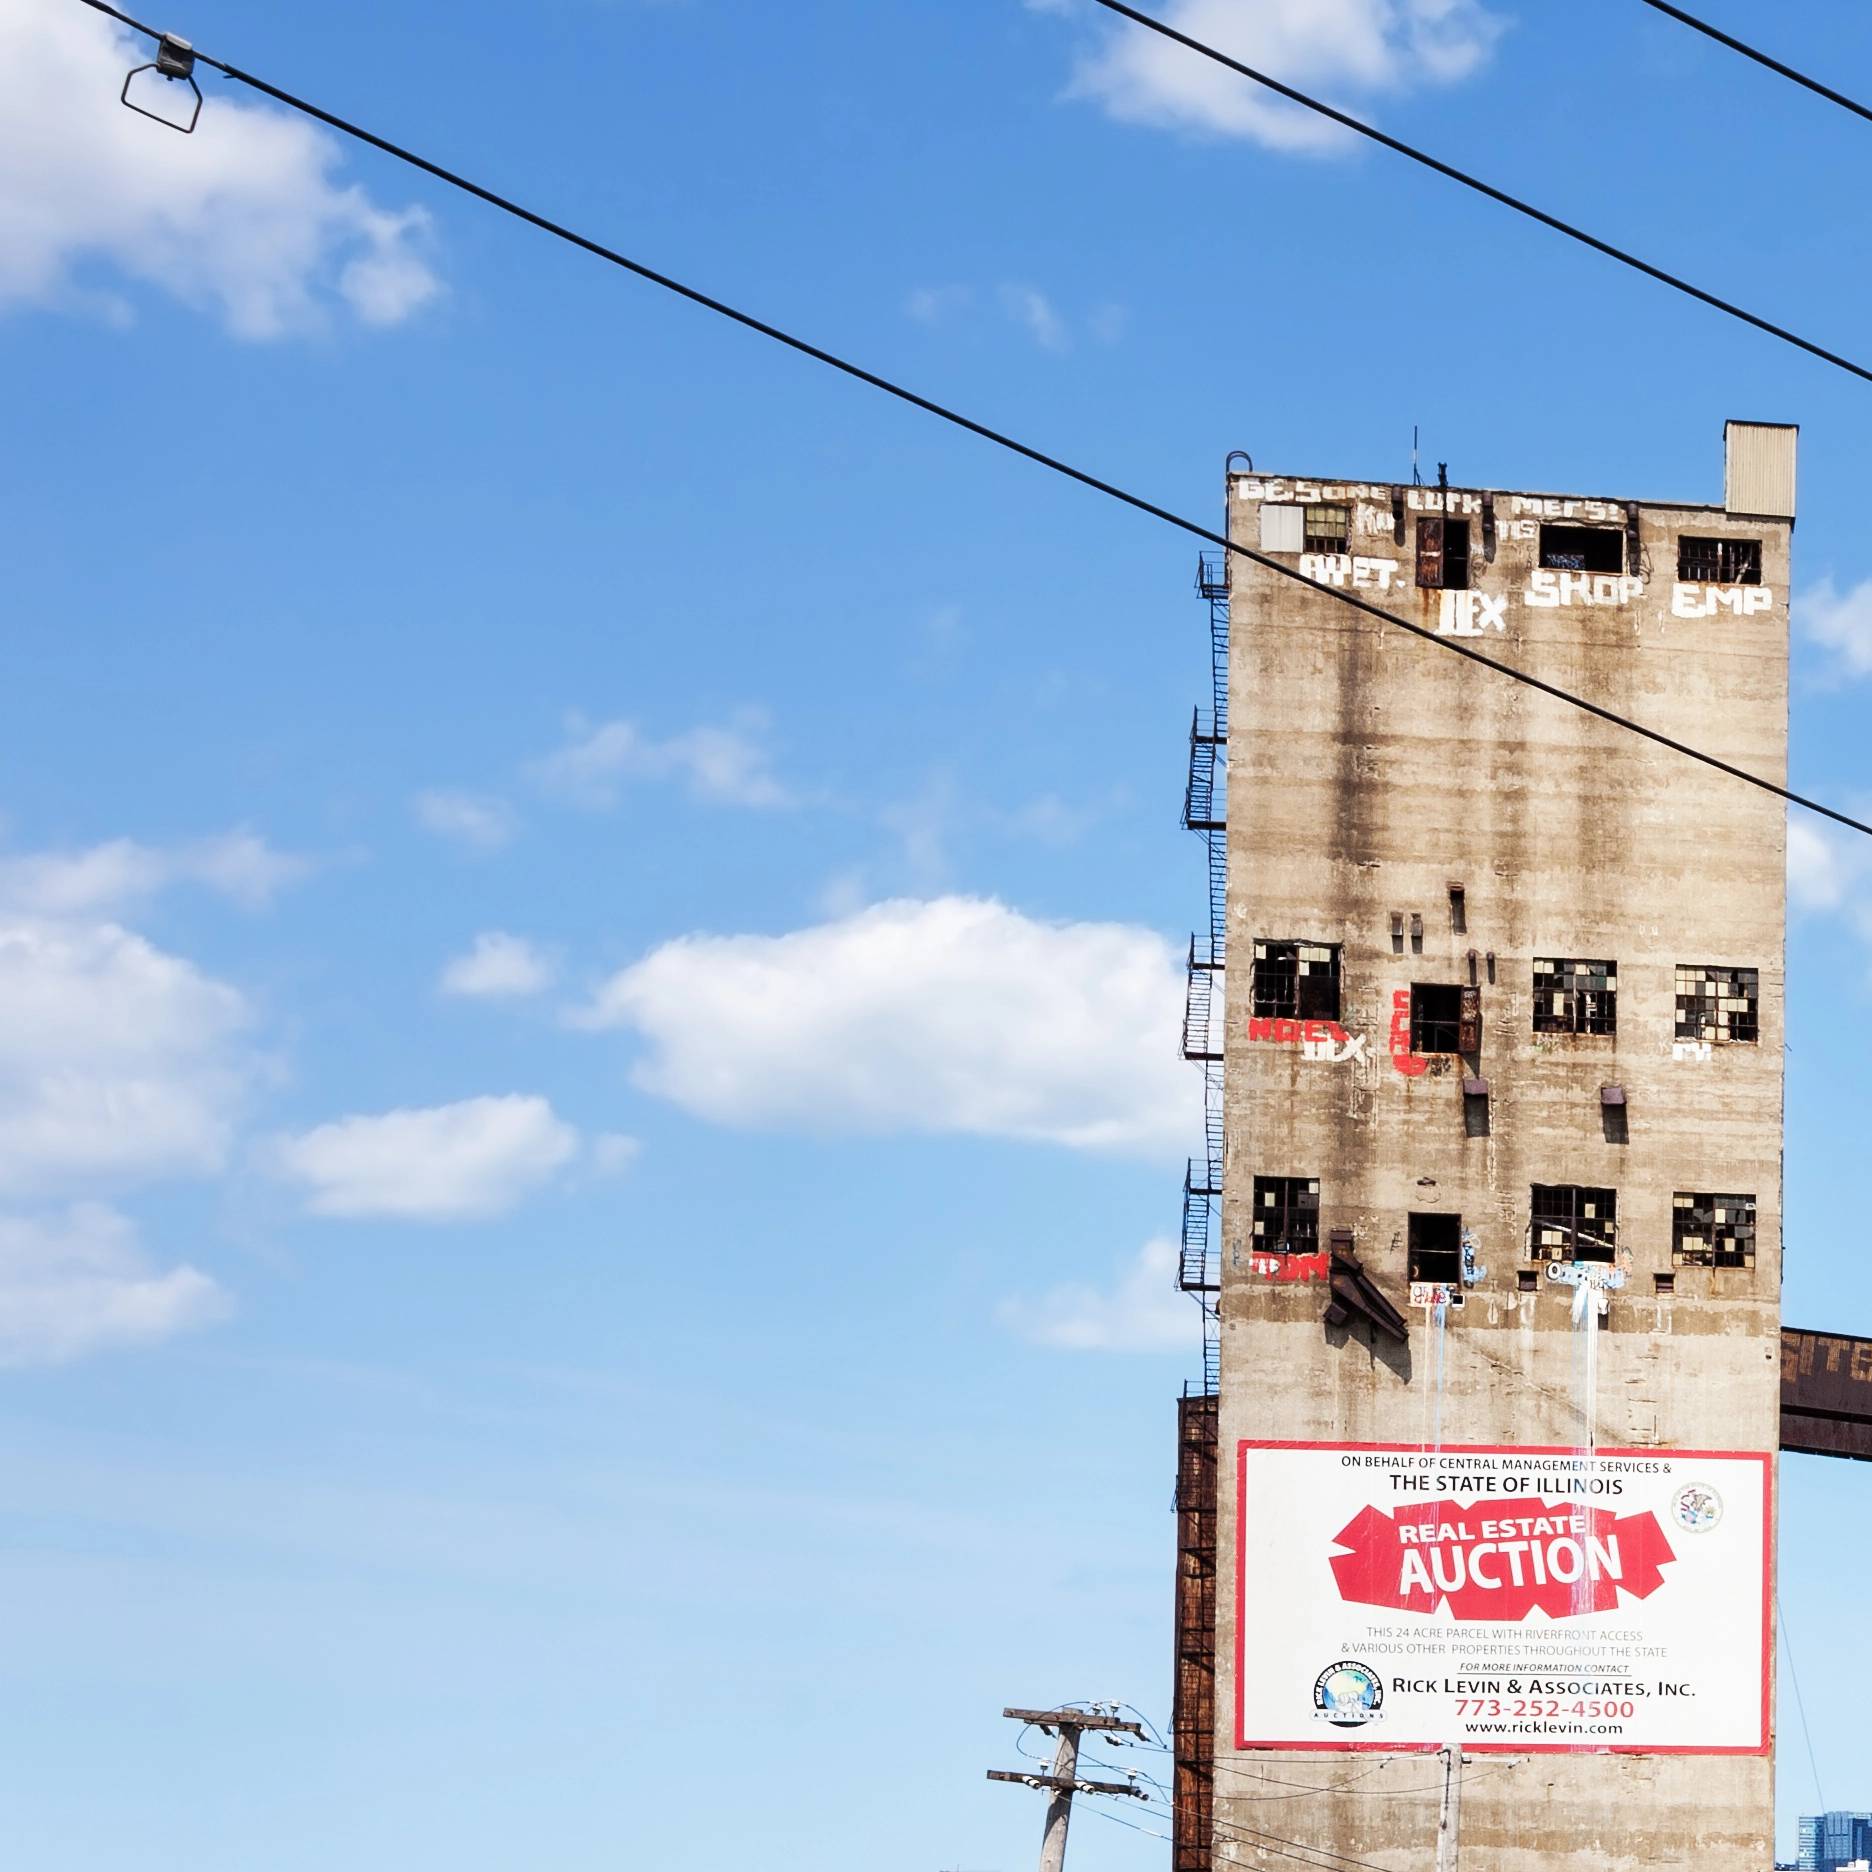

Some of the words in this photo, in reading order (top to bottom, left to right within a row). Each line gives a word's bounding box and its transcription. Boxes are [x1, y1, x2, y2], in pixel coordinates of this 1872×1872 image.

[1342, 1456, 1360, 1467] ON
[1365, 1457, 1414, 1468] BEHALF
[1419, 1458, 1435, 1469] OF
[1440, 1458, 1498, 1470] CENTRAL
[1502, 1460, 1596, 1473] MANAGEMENT
[1600, 1462, 1659, 1474] SERVICES
[1663, 1464, 1672, 1474] &
[1389, 1475, 1429, 1491] THE
[1436, 1476, 1496, 1493] STATE
[1502, 1477, 1530, 1493] OF
[1536, 1478, 1624, 1496] ILLINOIS
[1399, 1521, 1476, 1544] REAL
[1481, 1515, 1587, 1539] ESTATE
[1399, 1534, 1624, 1596] AUCTION
[1367, 1627, 1392, 1638] THIS
[1396, 1628, 1409, 1638] 24
[1413, 1628, 1442, 1639] ACRE
[1446, 1628, 1489, 1640] PARCEL
[1491, 1629, 1522, 1640] WITH
[1526, 1630, 1596, 1642] RIVERFRONT
[1600, 1631, 1643, 1642] ACCESS
[1341, 1643, 1350, 1654] &
[1352, 1643, 1403, 1655] VARIOUS
[1406, 1644, 1446, 1656] OTHER
[1452, 1644, 1521, 1656] PROPERTIES
[1523, 1645, 1607, 1658] THROUGHOUT
[1610, 1647, 1632, 1657] THE
[1634, 1647, 1667, 1658] STATE
[1460, 1663, 1479, 1671] FOR
[1482, 1663, 1511, 1672] MORE
[1513, 1664, 1581, 1673] INFORMATION
[1584, 1665, 1629, 1674] CONTACT
[1393, 1678, 1436, 1694] RICK
[1444, 1679, 1500, 1695] LEVIN
[1507, 1680, 1523, 1695] &
[1529, 1680, 1651, 1699] ASSOCIATES,
[1658, 1681, 1697, 1698] INC.
[1454, 1699, 1635, 1719] 773-252-4500
[1465, 1720, 1623, 1735] www.ricklevin.com
